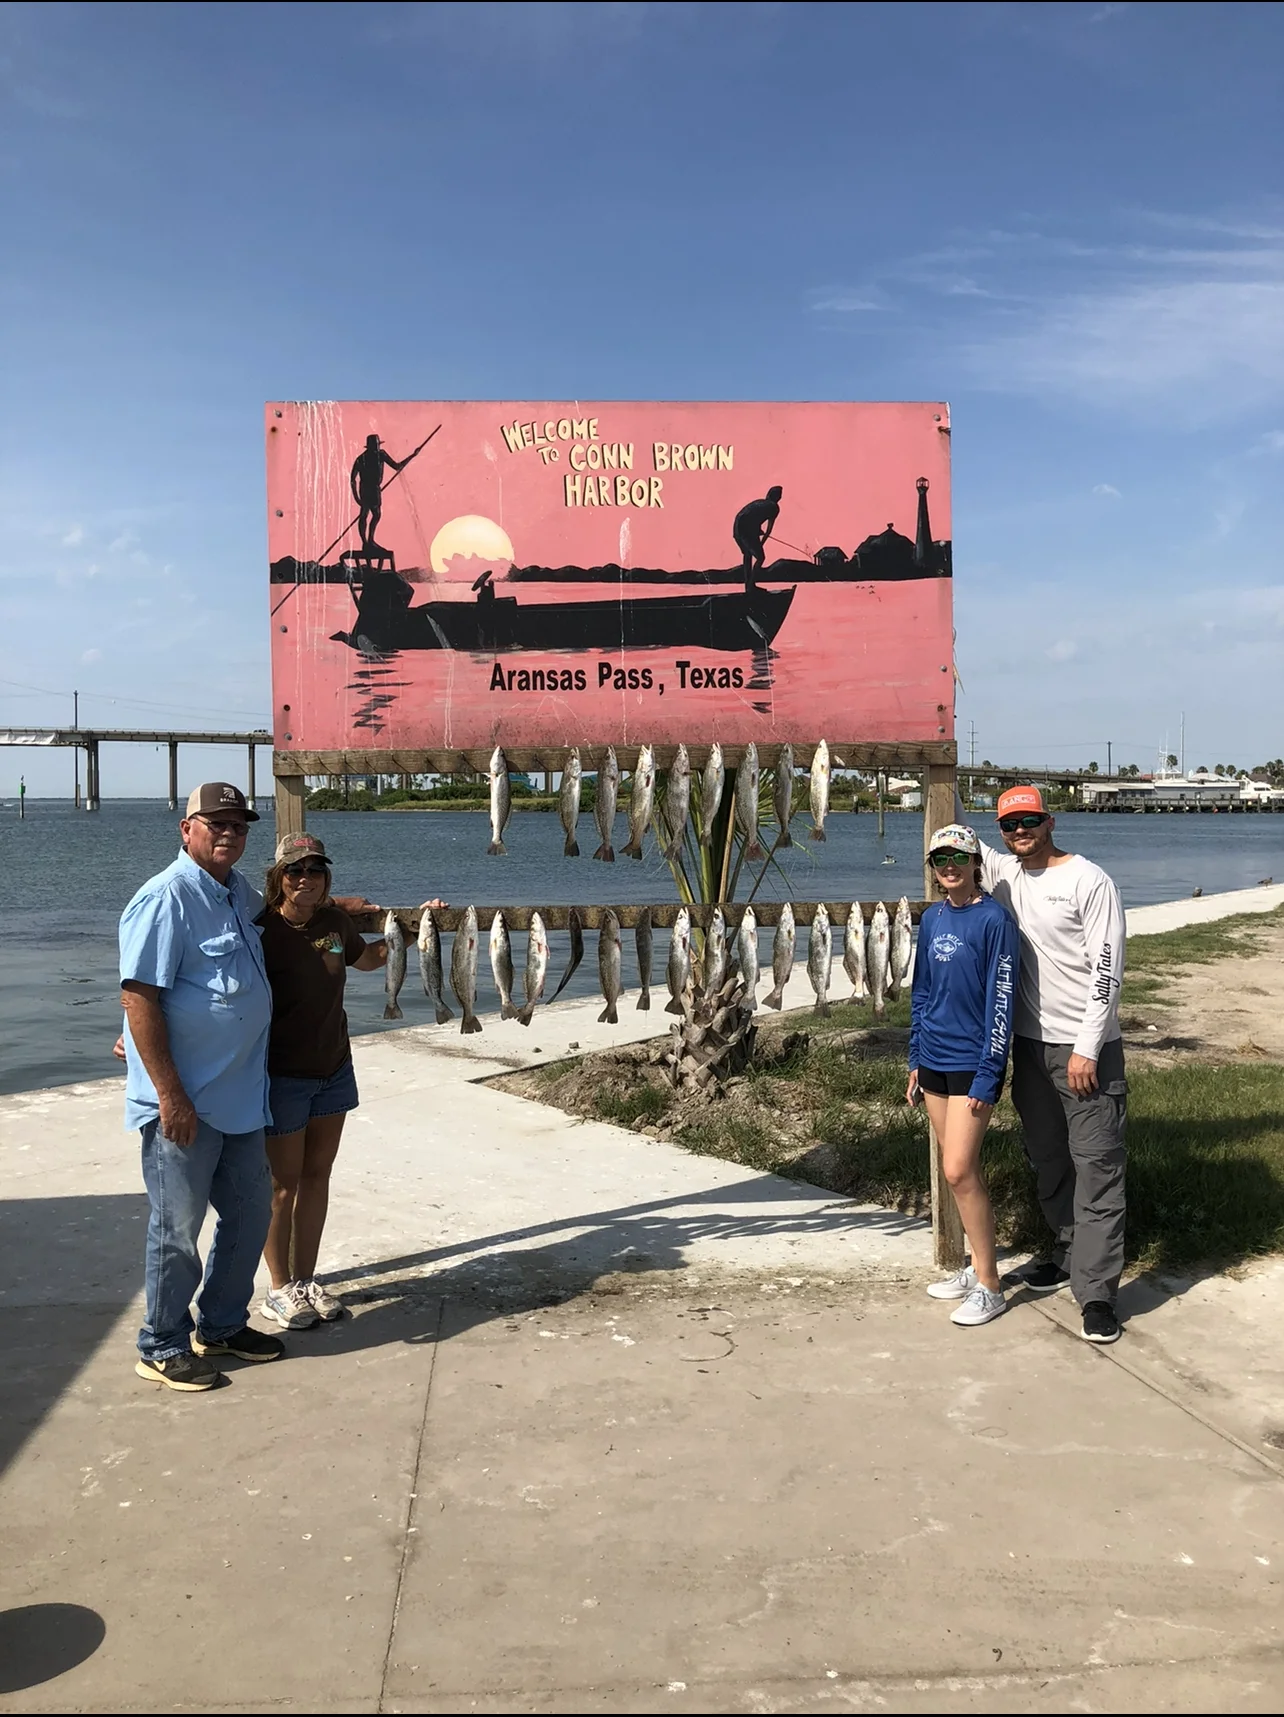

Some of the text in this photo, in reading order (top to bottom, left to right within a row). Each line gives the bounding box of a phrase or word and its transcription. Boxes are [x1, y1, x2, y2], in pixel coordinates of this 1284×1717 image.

[500, 418, 600, 453] WELCOME
[536, 441, 734, 472] TO CONN BROWN
[564, 473, 664, 508] HARBOR
[489, 662, 587, 691] Aransas
[676, 661, 743, 689] Texas
